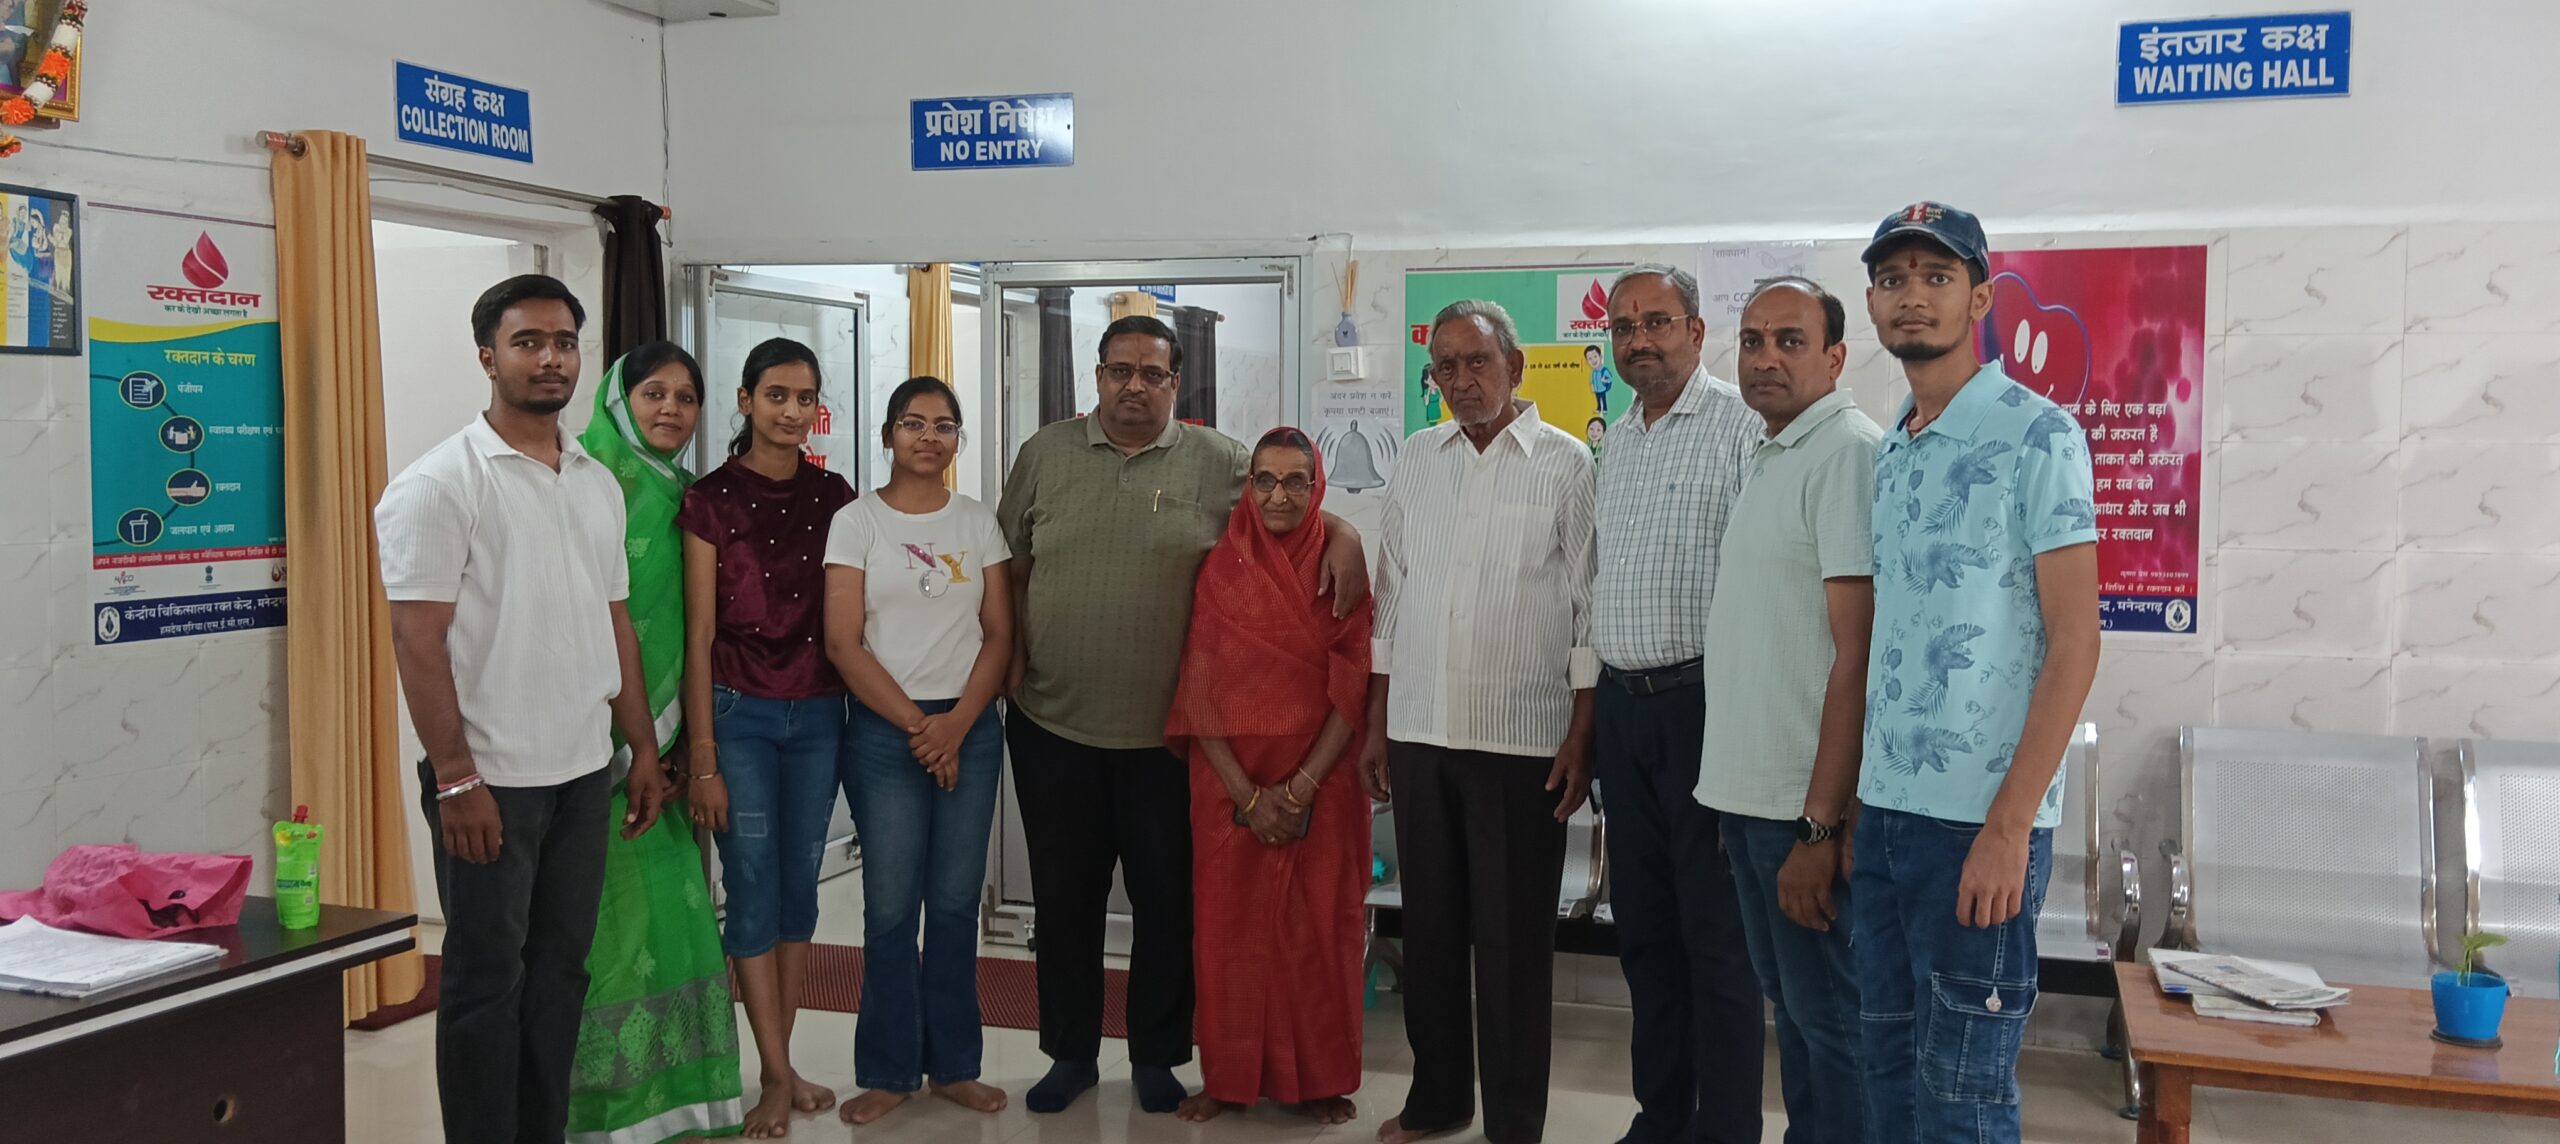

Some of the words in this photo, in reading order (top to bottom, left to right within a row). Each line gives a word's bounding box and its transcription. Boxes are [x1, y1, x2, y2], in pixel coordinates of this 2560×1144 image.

[2138, 26, 2247, 64] इंतजार
[2261, 24, 2330, 52] कक्ष
[2134, 61, 2253, 94] WAITING
[2262, 58, 2334, 89] HALL
[424, 74, 467, 113] संग्रह
[472, 88, 505, 117] कक्ष
[401, 104, 488, 146] COLLECTION
[491, 123, 529, 154] ROOM
[924, 102, 983, 138] प्रवेश
[941, 140, 970, 162] NO
[975, 139, 1044, 161] ENTRY
[146, 285, 261, 307] रक्तदान
[1733, 293, 1752, 302] CCT
[164, 349, 210, 366] रक्तदान
[212, 347, 225, 365] के
[226, 353, 256, 367] चरण
[2085, 399, 2097, 416] के
[2101, 399, 2121, 418] लिए
[2125, 403, 2144, 418] एक
[2147, 403, 2167, 418] बड़ा
[2091, 424, 2106, 441] की
[2150, 424, 2158, 442] है
[2095, 453, 2125, 466] ताकत
[2129, 448, 2144, 466] की
[2096, 479, 2112, 493] हम
[2116, 479, 2133, 491] सब
[2137, 474, 2154, 491] बने
[2128, 498, 2148, 516] और
[2152, 504, 2170, 516] जब
[2174, 499, 2187, 517] भी
[2111, 528, 2154, 541] रक्तदान
[124, 606, 156, 621] केन्द्रीय
[157, 602, 213, 618] चिकित्सालय
[213, 600, 232, 612] रक्त
[2117, 598, 2163, 616] मनेन्द्रगढ़
